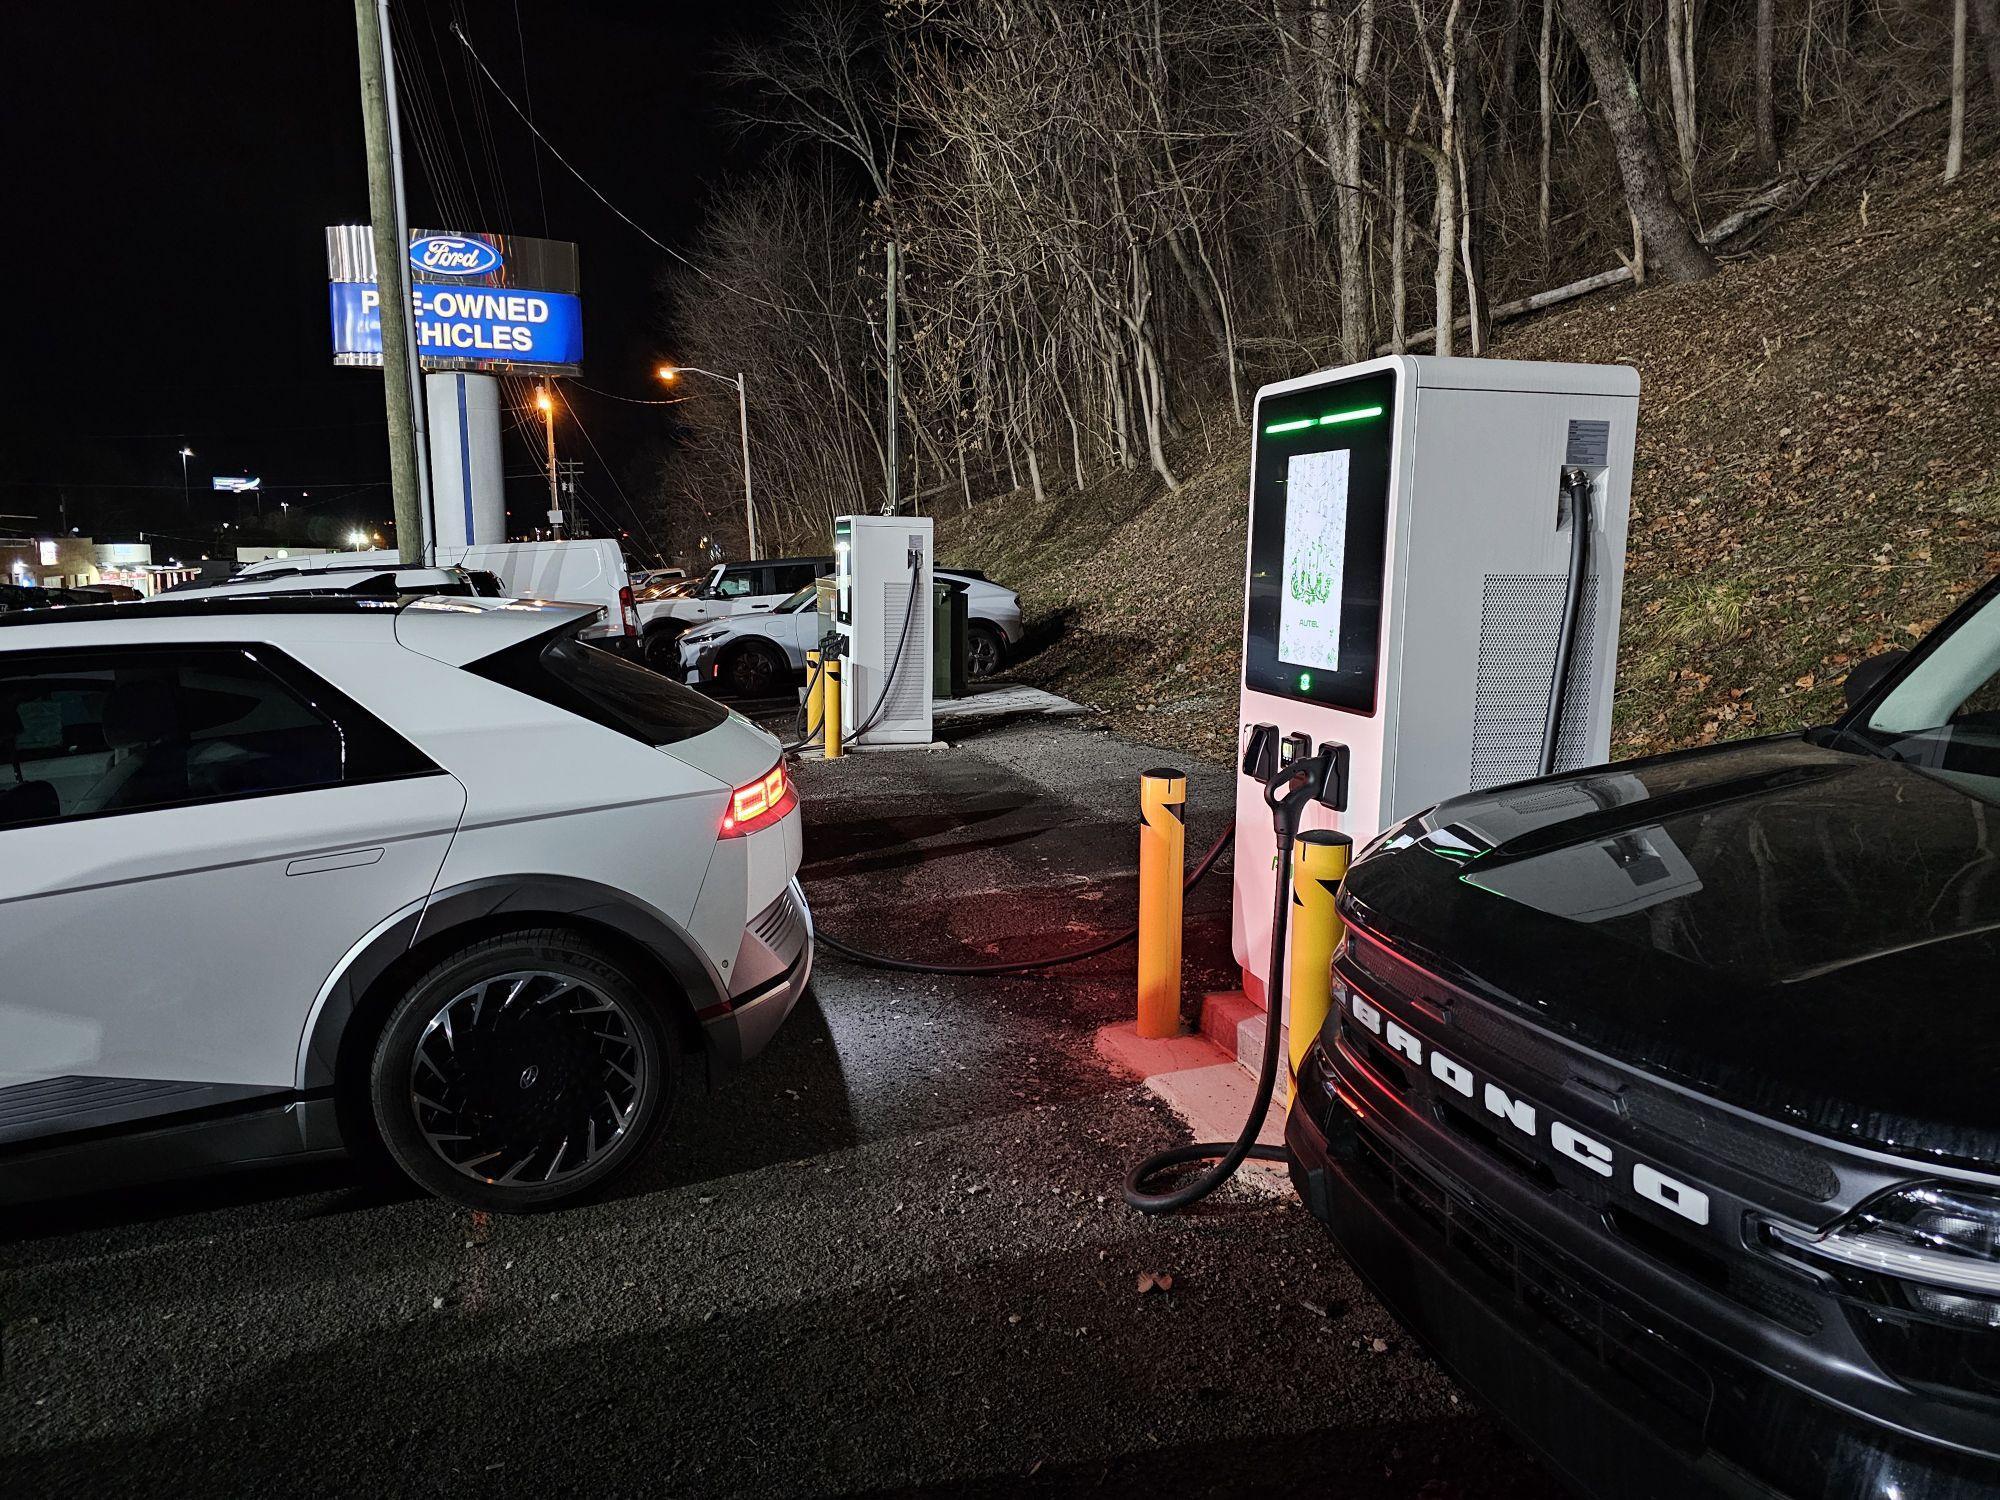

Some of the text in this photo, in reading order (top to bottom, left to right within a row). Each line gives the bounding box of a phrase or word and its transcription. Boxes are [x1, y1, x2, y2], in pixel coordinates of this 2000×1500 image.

[423, 240, 480, 267] Ford
[361, 290, 549, 323] PE-OWNED
[415, 321, 533, 352] HICLES
[1299, 619, 1320, 629] AUTEL
[1352, 994, 1710, 1226] BRONCO
